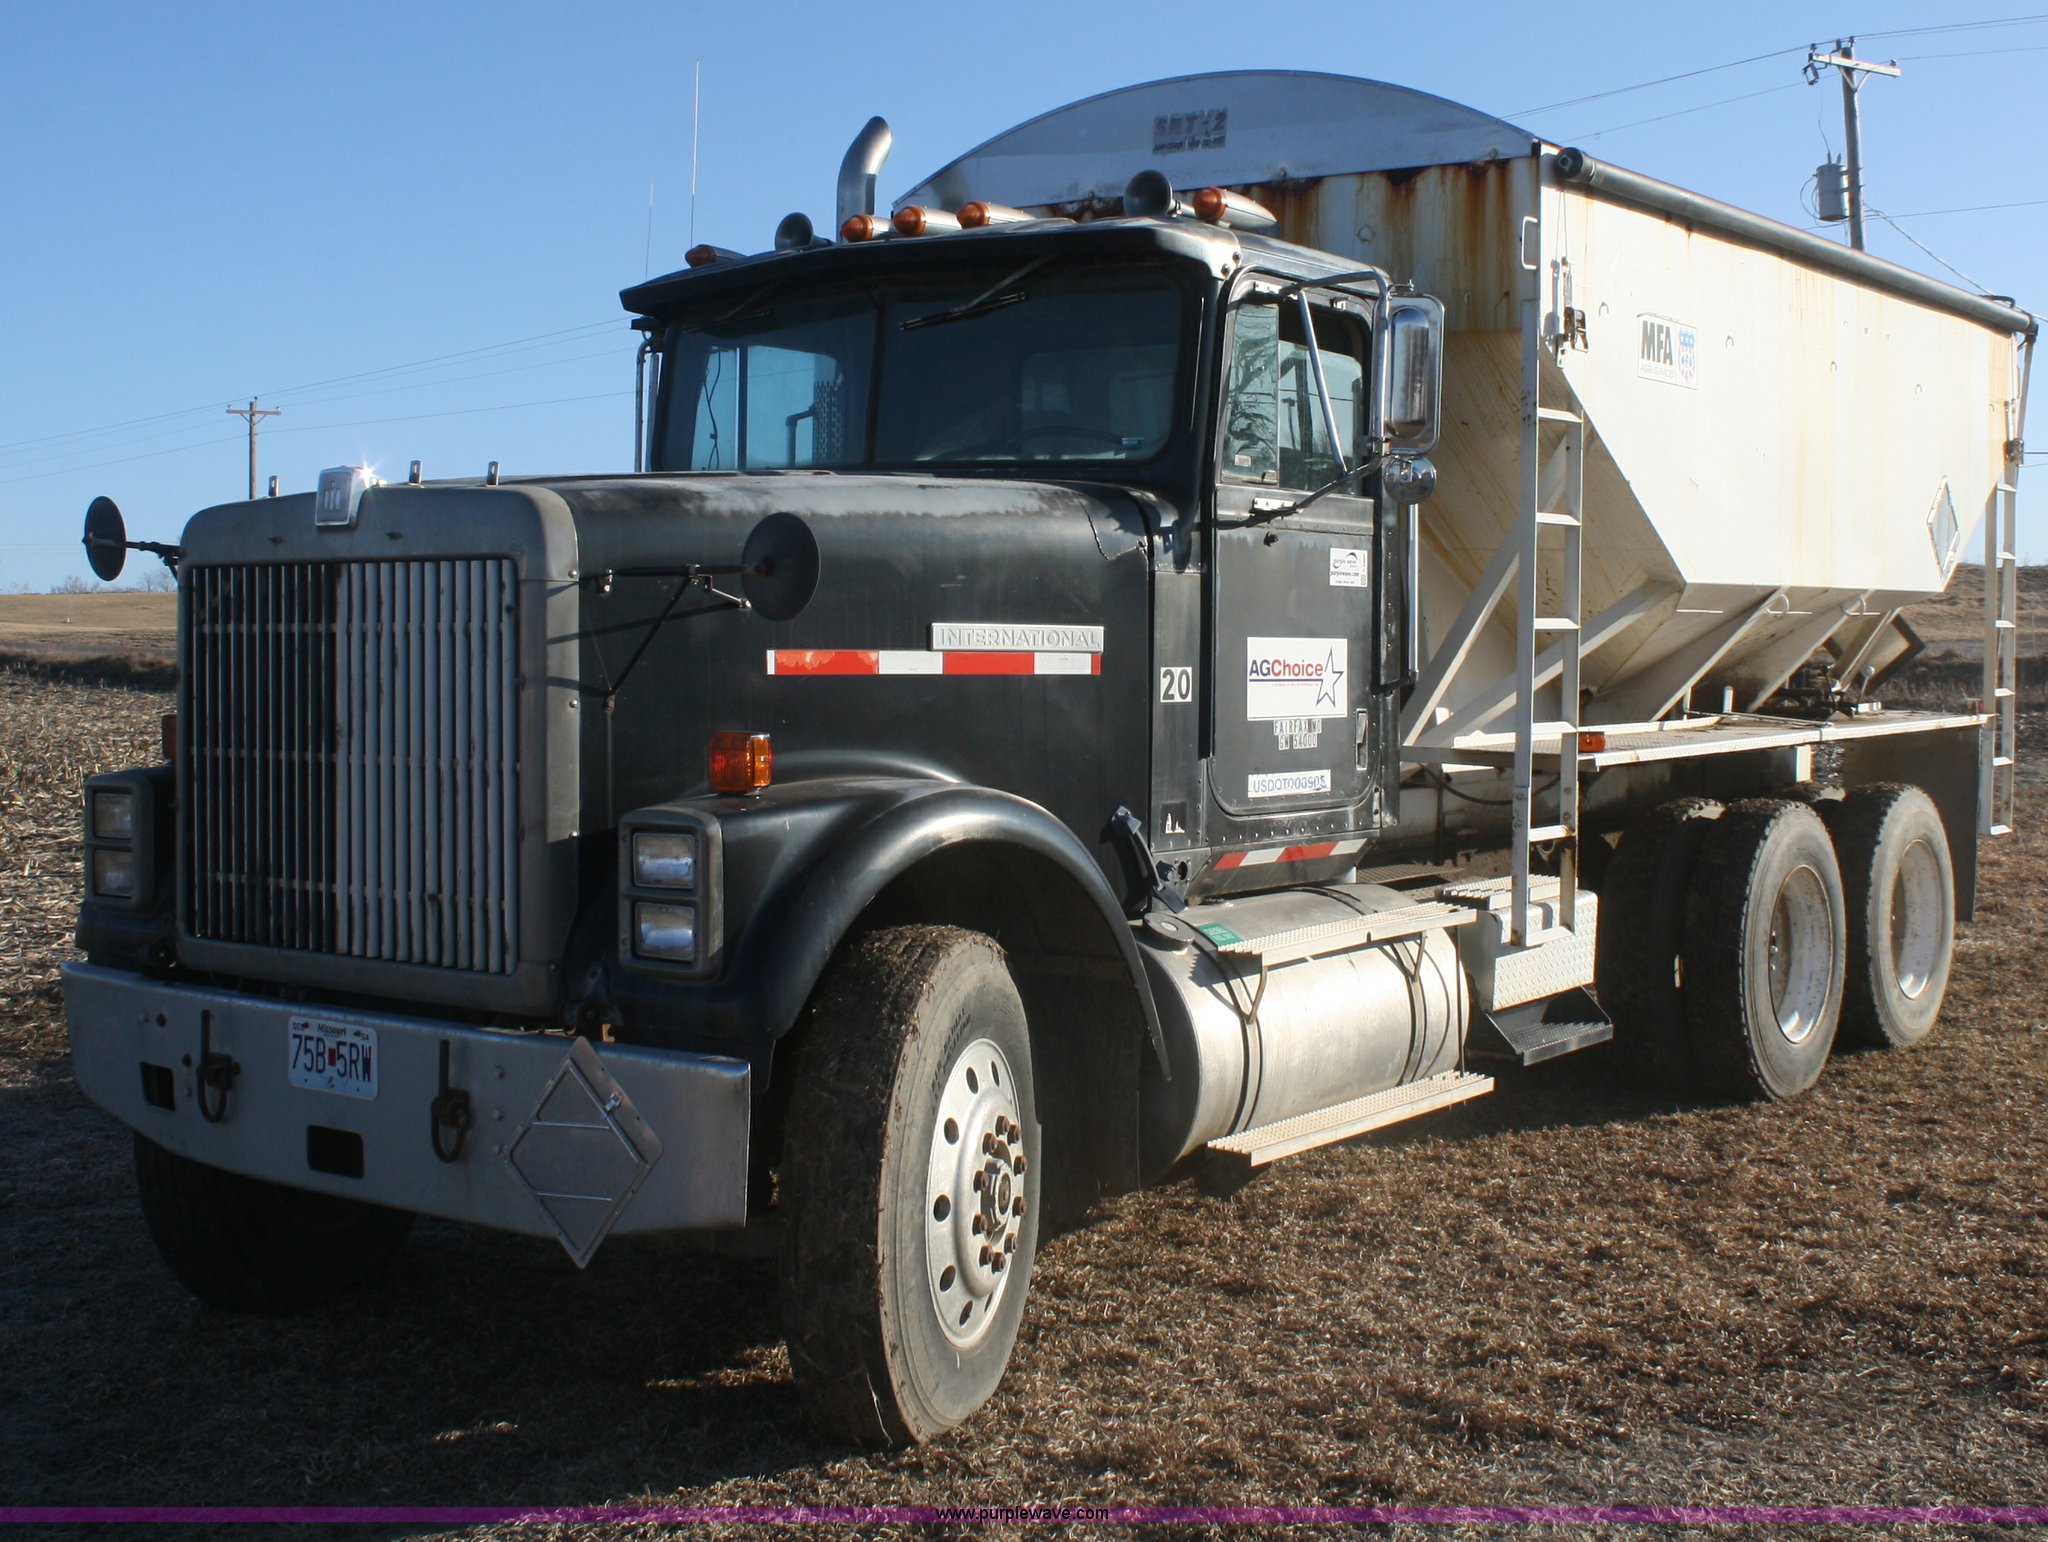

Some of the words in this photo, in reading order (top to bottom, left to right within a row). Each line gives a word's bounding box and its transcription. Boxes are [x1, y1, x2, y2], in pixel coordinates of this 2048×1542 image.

[1641, 320, 1673, 366] MFA
[940, 628, 1100, 648] INTERNATIONAL
[1249, 659, 1324, 677] AGChoice
[1161, 668, 1191, 701] 20
[1275, 719, 1308, 734] FAIRFAX
[318, 1023, 347, 1036] Missouri
[292, 1033, 327, 1074] 75B
[336, 1040, 372, 1082] 5RW
